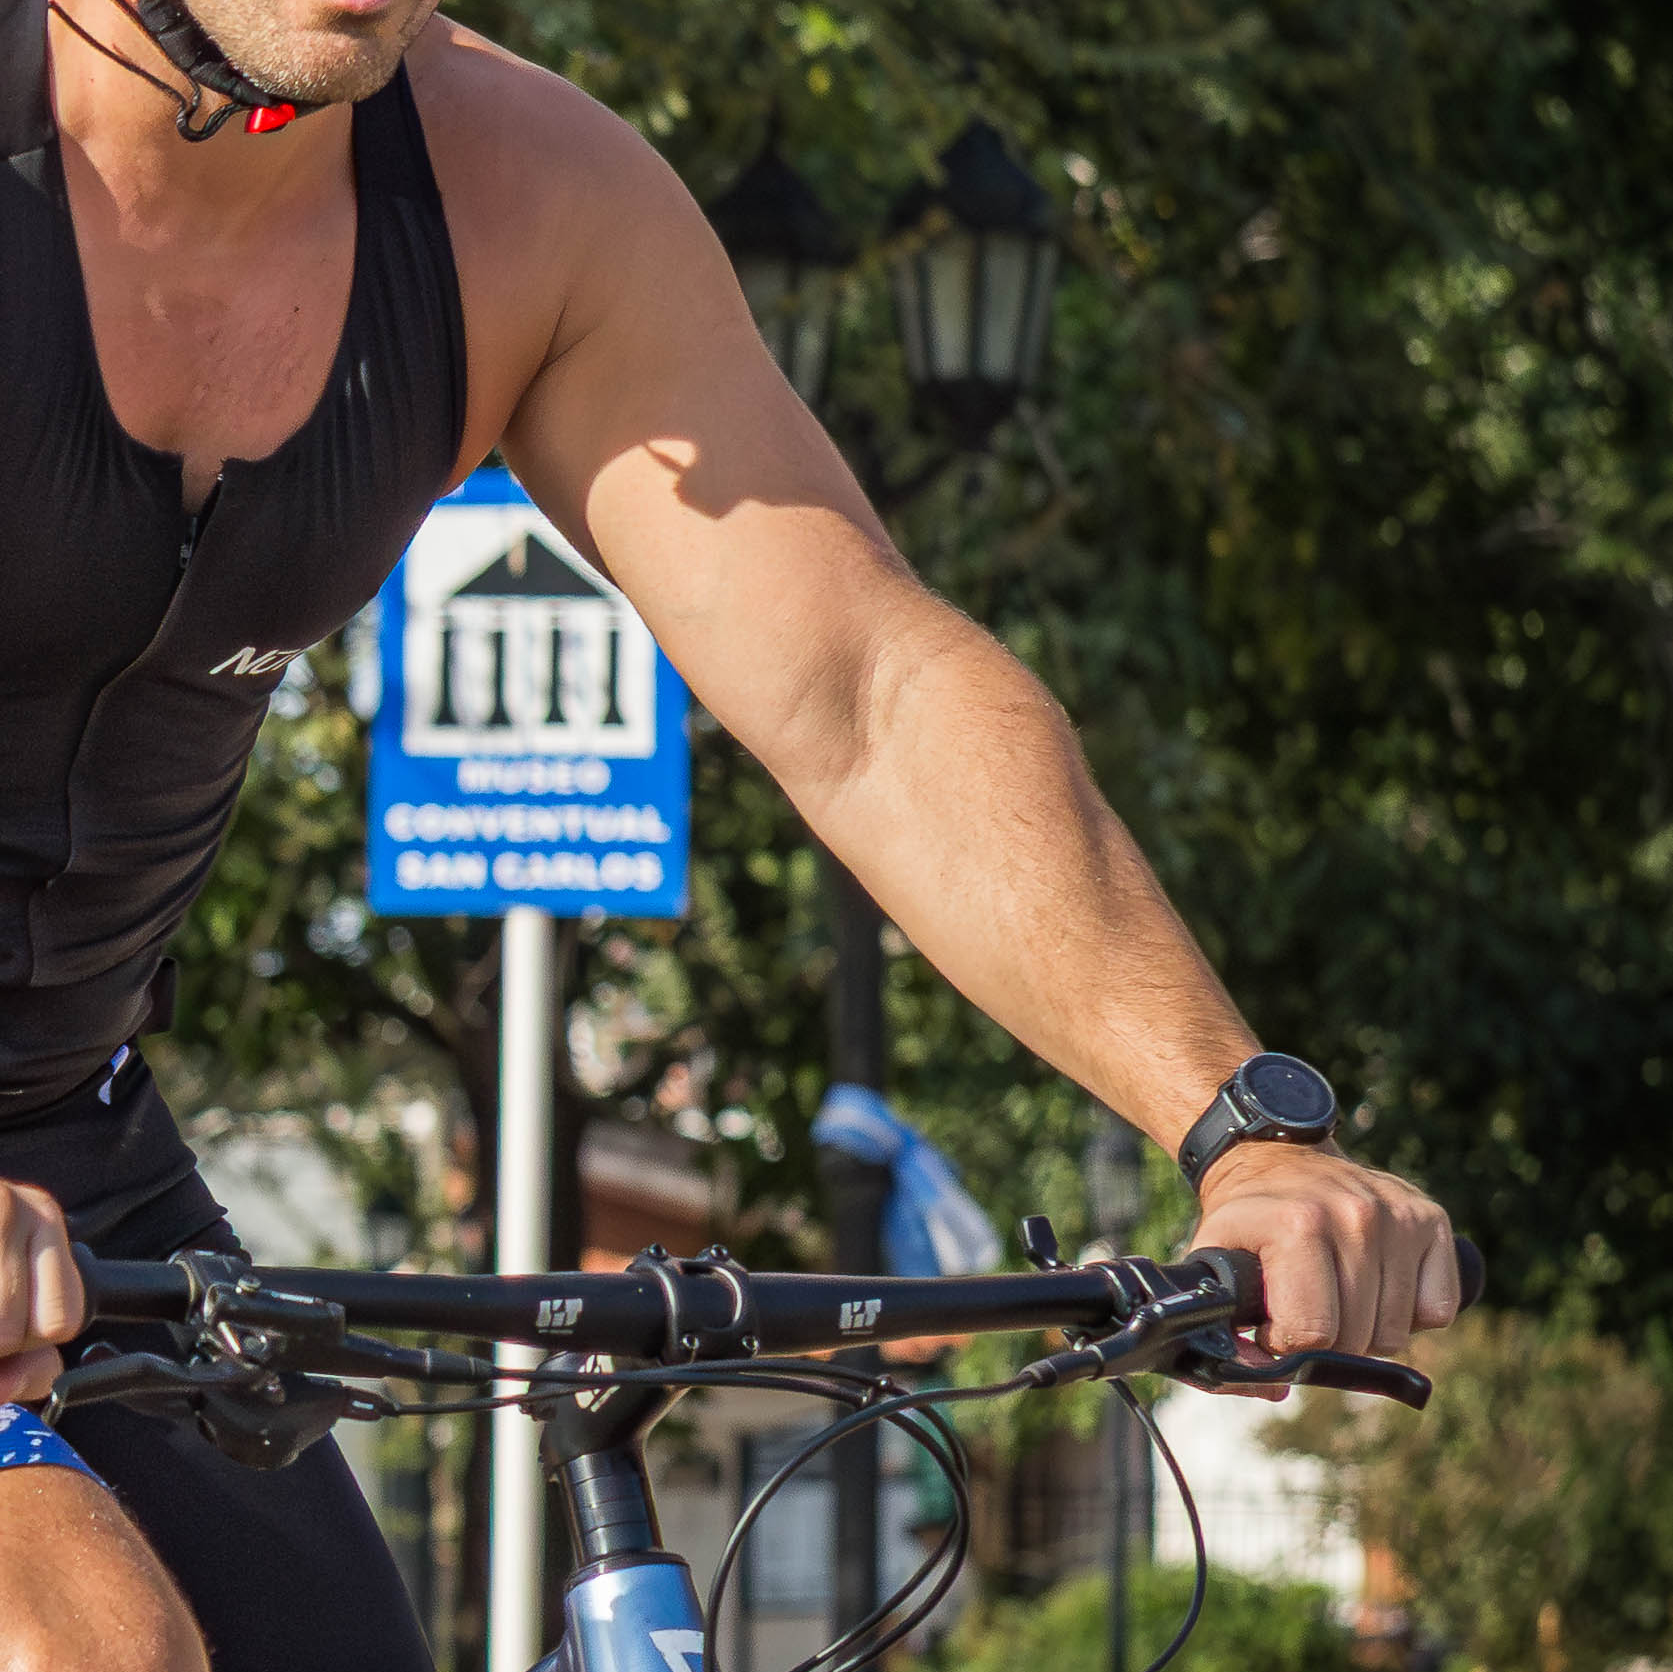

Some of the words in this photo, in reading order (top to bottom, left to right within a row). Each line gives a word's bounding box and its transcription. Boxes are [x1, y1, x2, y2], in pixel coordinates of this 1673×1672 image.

[384, 802, 672, 844] CONVENTUAL
[396, 850, 488, 891] SAN
[492, 851, 663, 892] CARLOS
